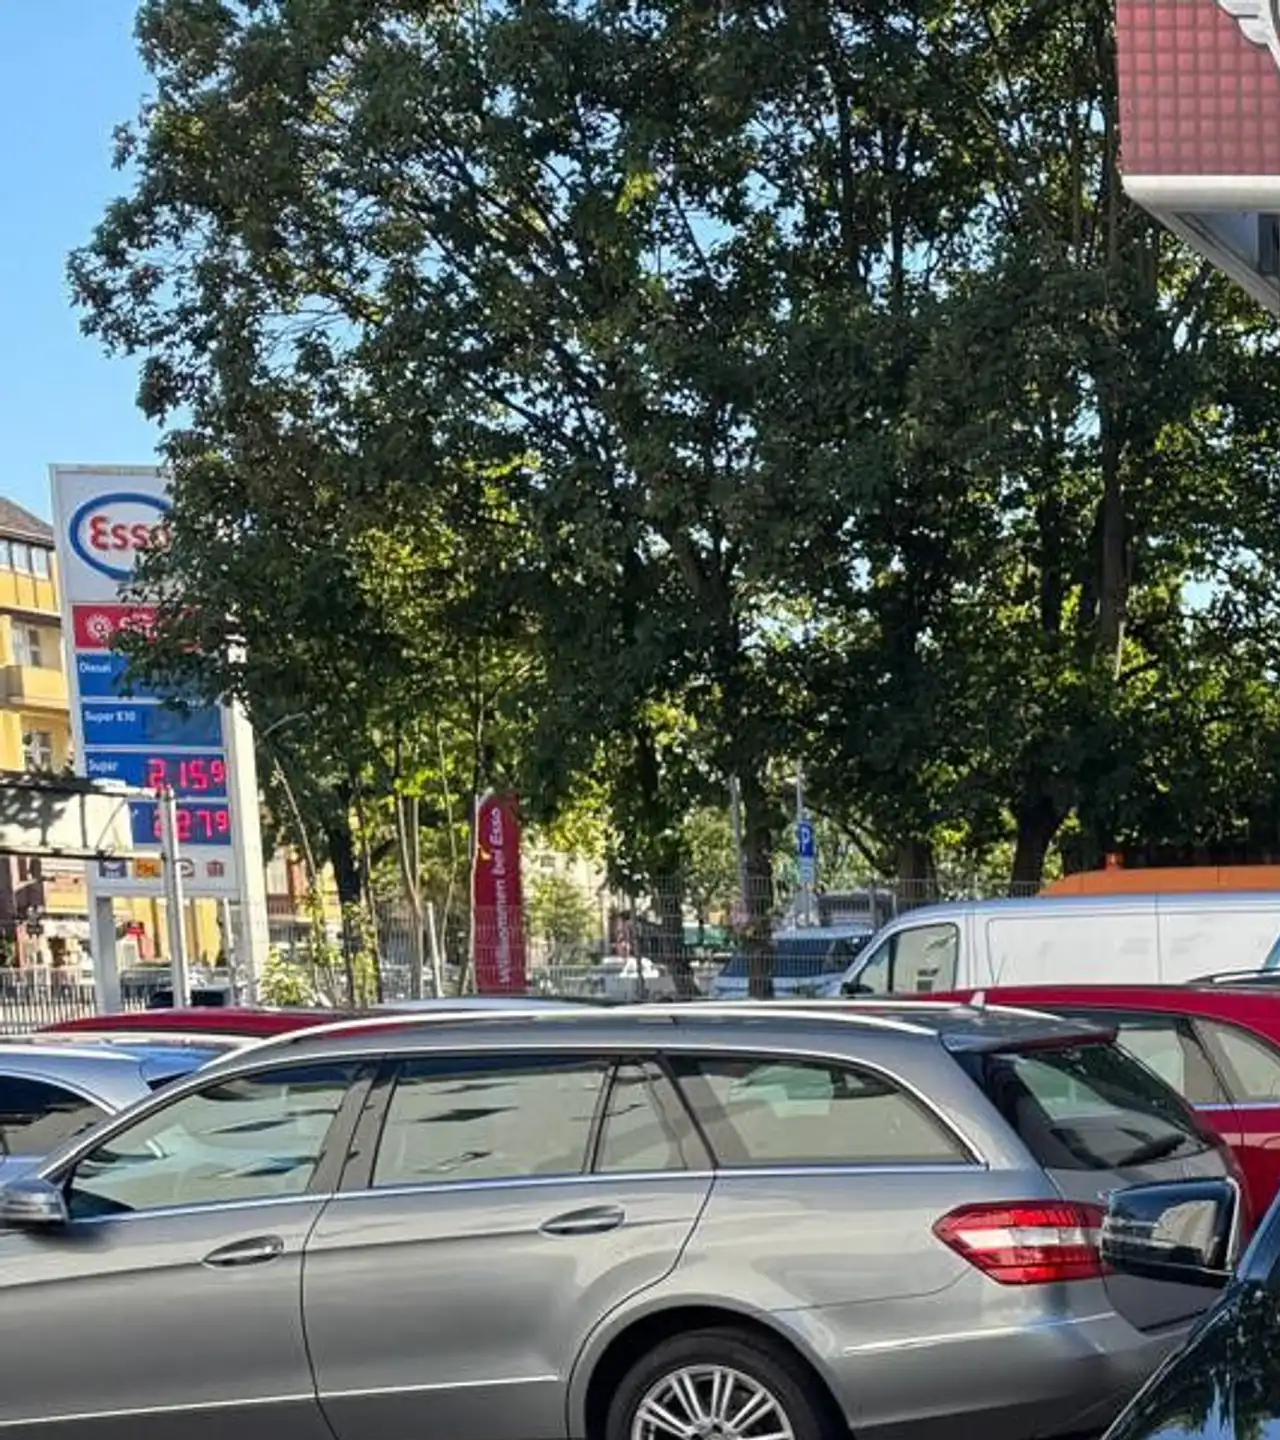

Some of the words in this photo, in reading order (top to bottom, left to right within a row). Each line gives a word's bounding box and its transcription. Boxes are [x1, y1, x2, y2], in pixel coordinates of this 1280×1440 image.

[89, 515, 173, 552] Esso
[84, 711, 114, 724] Super
[88, 758, 120, 774] Super
[489, 808, 504, 846] Esso
